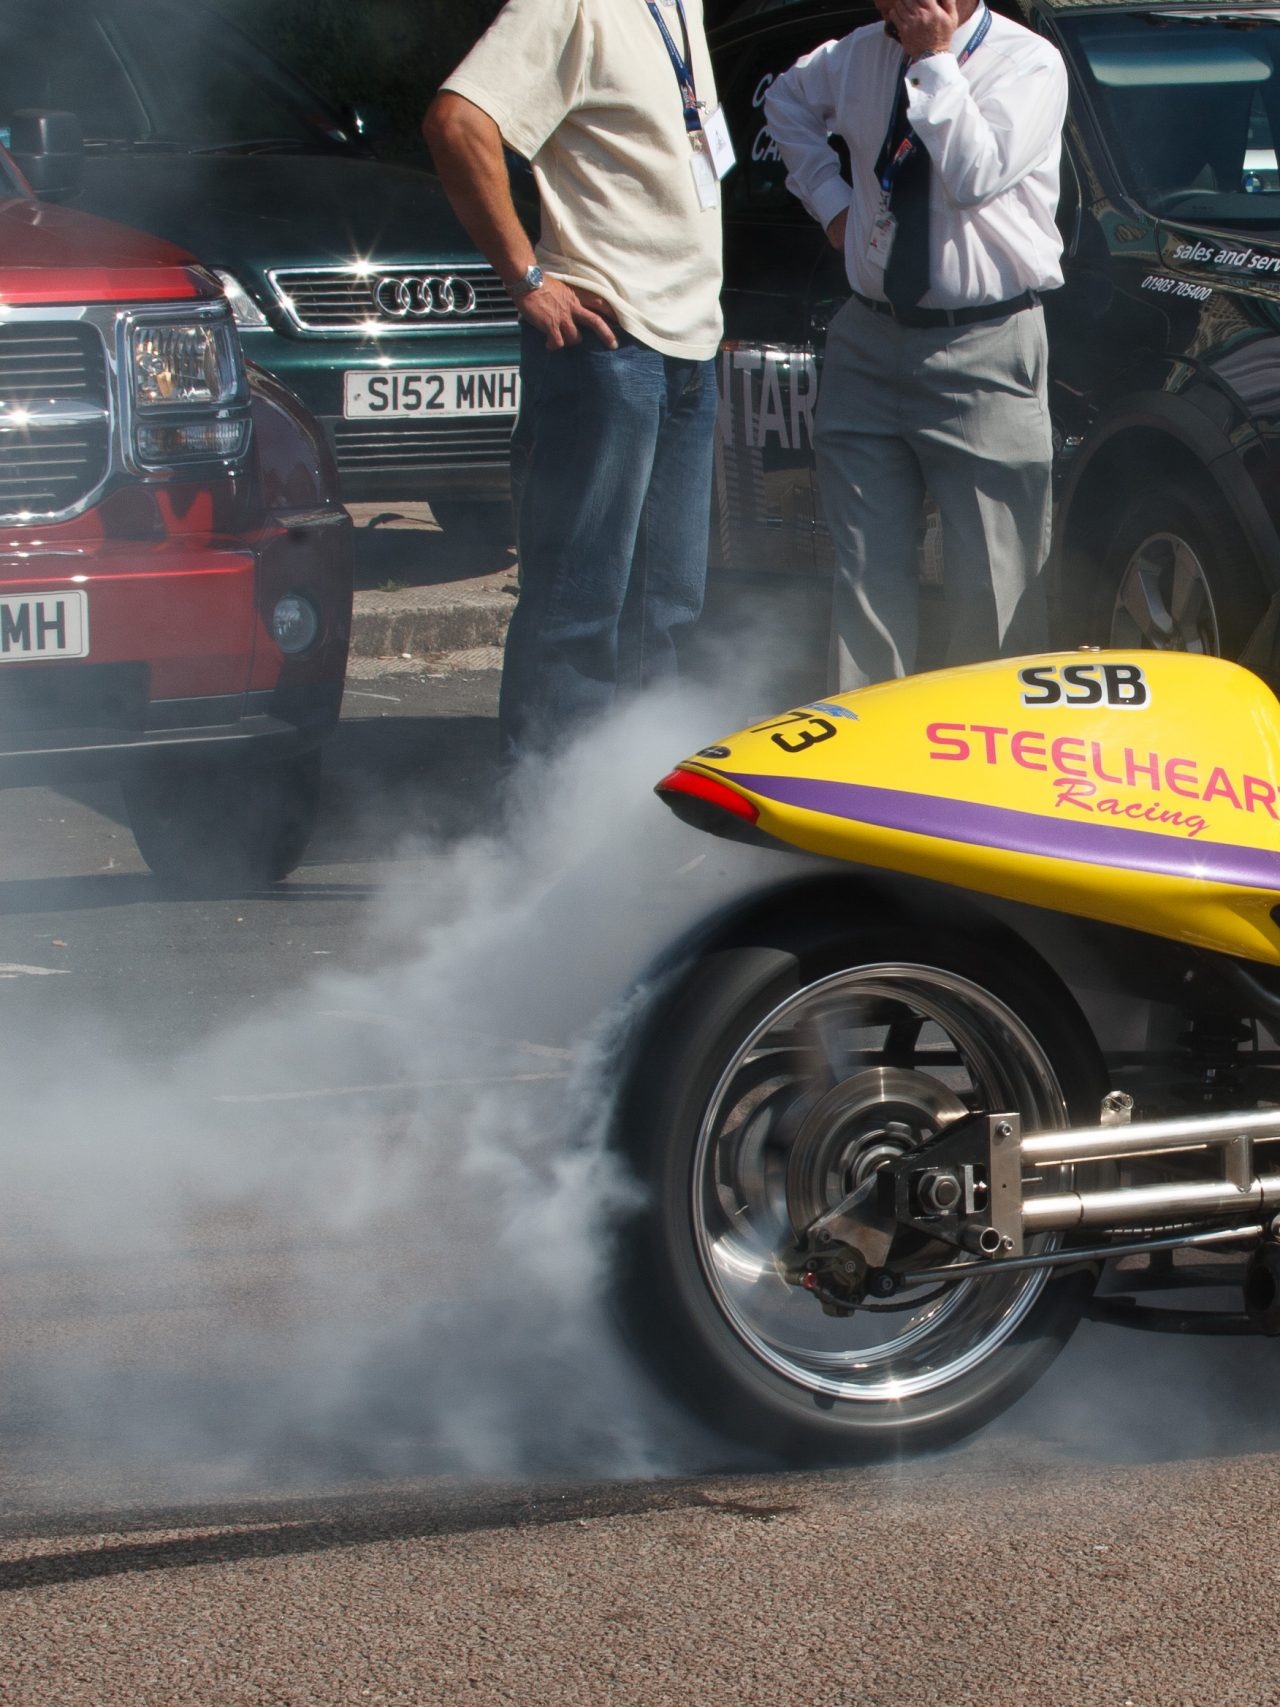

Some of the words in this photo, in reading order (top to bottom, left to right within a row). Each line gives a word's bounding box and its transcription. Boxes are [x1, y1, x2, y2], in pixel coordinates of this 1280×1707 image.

[1173, 242, 1214, 262] sales
[1214, 249, 1252, 266] and
[1141, 275, 1175, 293] 01903
[456, 372, 517, 409] MNH
[1019, 664, 1150, 708] SSB
[1053, 777, 1211, 838] Racing
